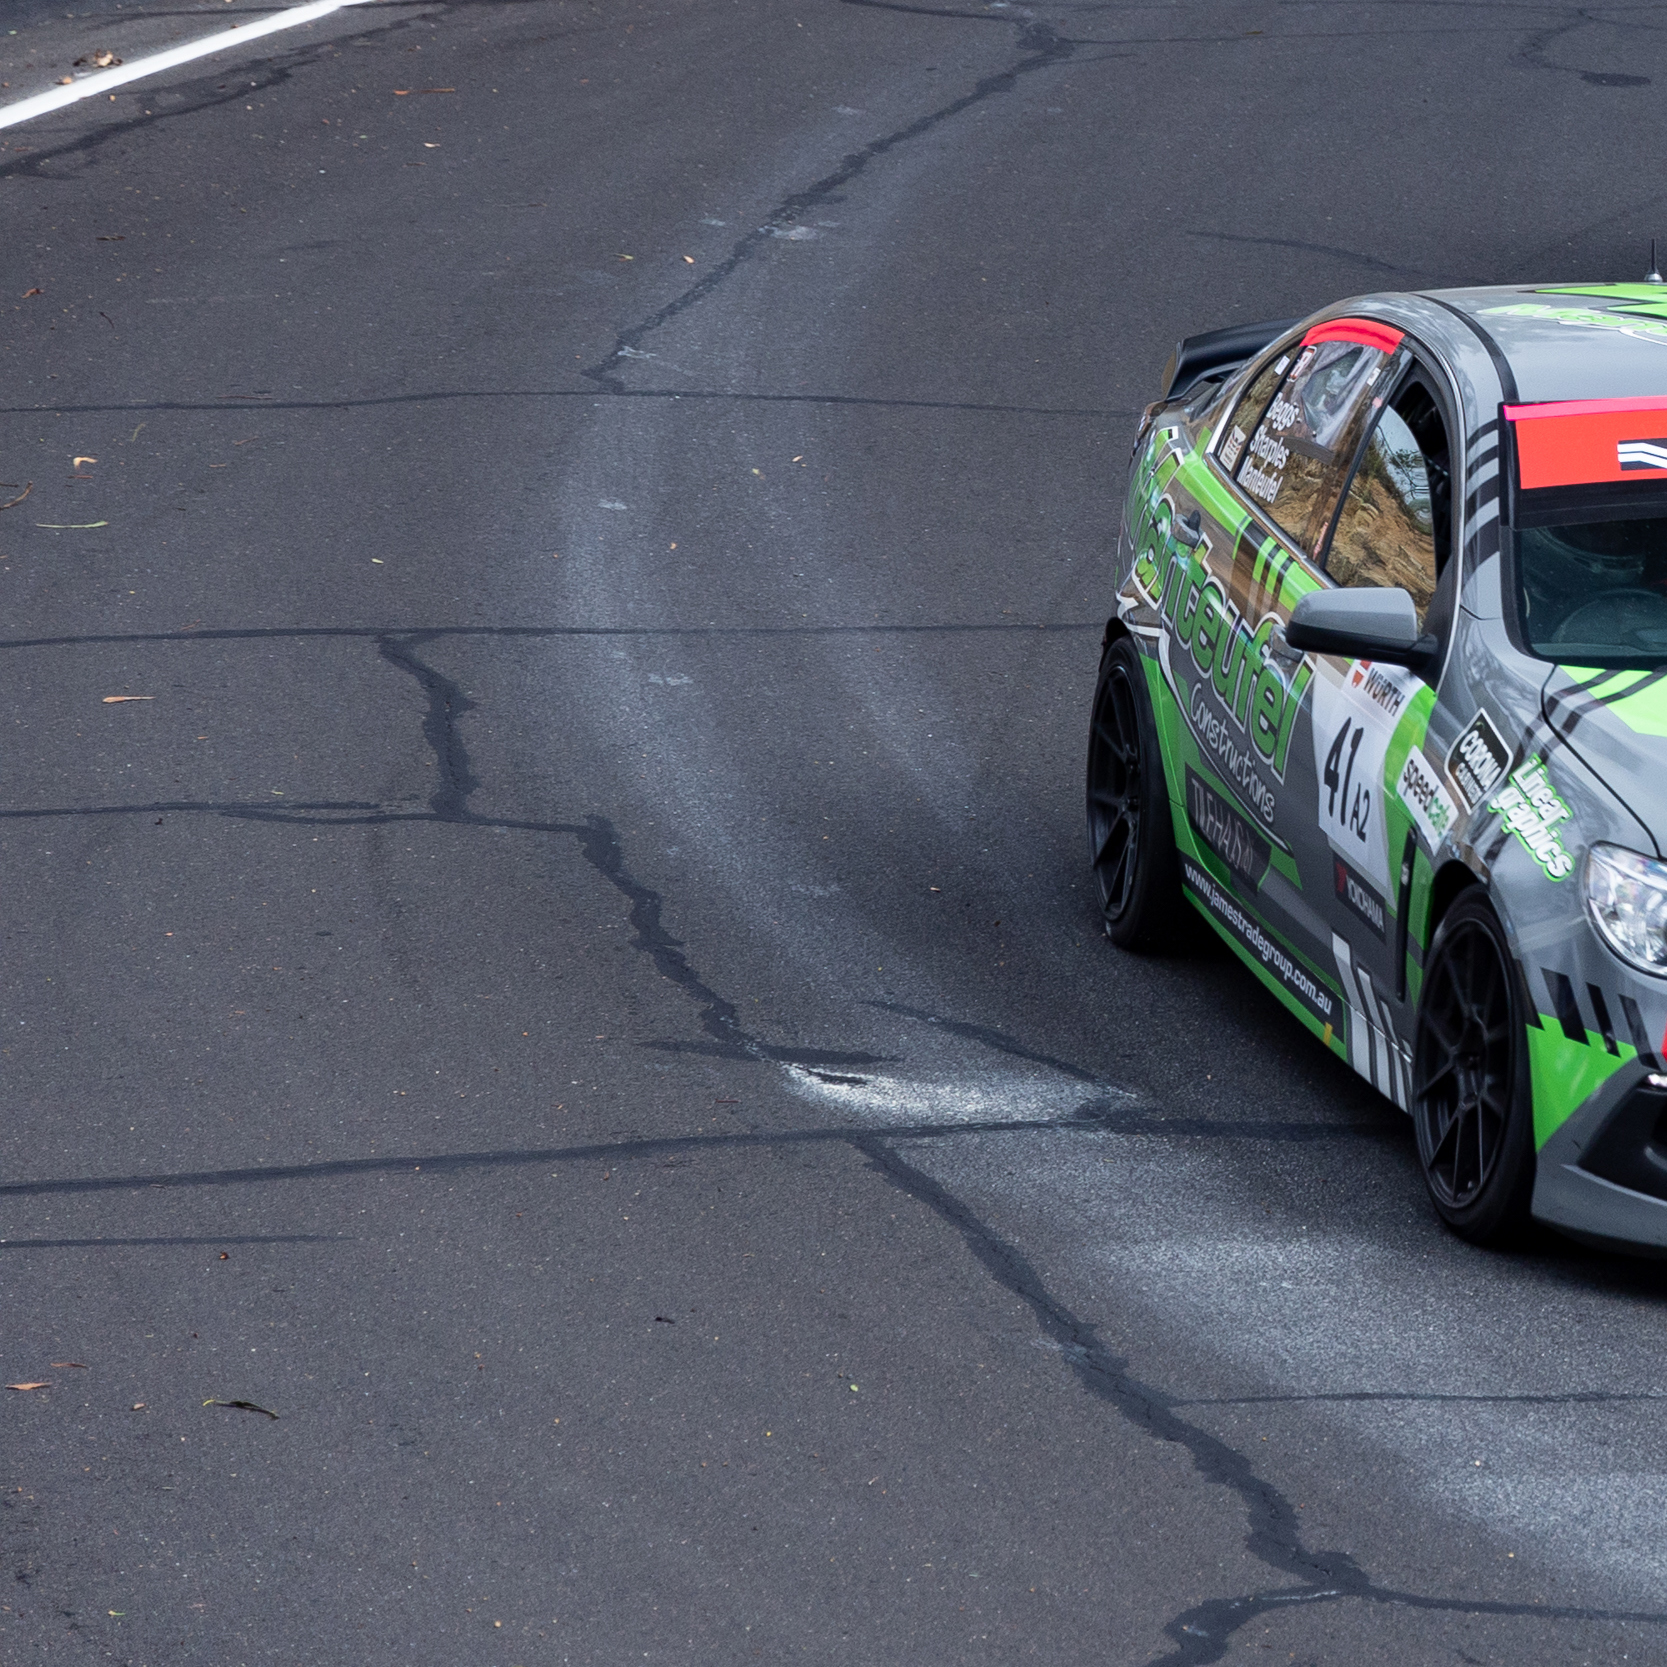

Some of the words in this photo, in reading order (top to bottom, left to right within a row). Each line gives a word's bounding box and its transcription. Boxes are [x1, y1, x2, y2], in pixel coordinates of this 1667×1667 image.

[1324, 716, 1364, 827] 41
[1350, 782, 1371, 843] A2
[1490, 786, 1575, 879] graphics
[1184, 862, 1334, 1016] www.jamestradegroup.com.au
